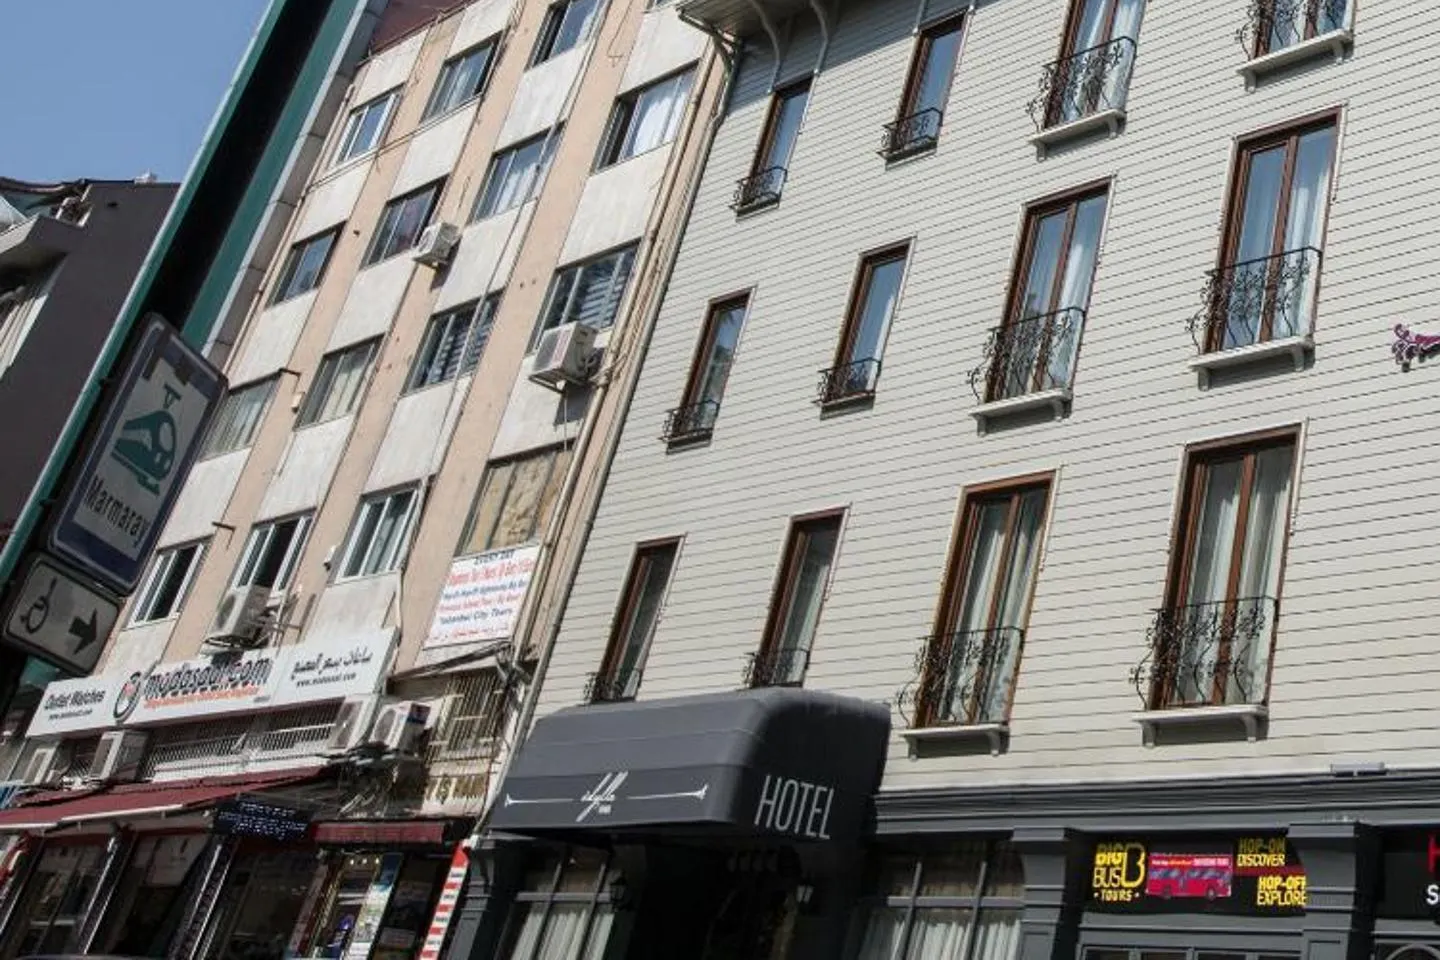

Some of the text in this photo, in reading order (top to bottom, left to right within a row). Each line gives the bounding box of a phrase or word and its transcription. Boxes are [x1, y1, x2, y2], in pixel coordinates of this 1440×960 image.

[86, 475, 150, 548] Marmaray
[754, 775, 834, 839] HOTEL
[1095, 843, 1123, 866] BIG
[1238, 838, 1286, 853] HOP-ON
[1237, 853, 1286, 867] DISCOVER
[1093, 867, 1122, 888] BUS
[1100, 889, 1133, 902] TOURS
[1256, 890, 1307, 906] EXPLORE
